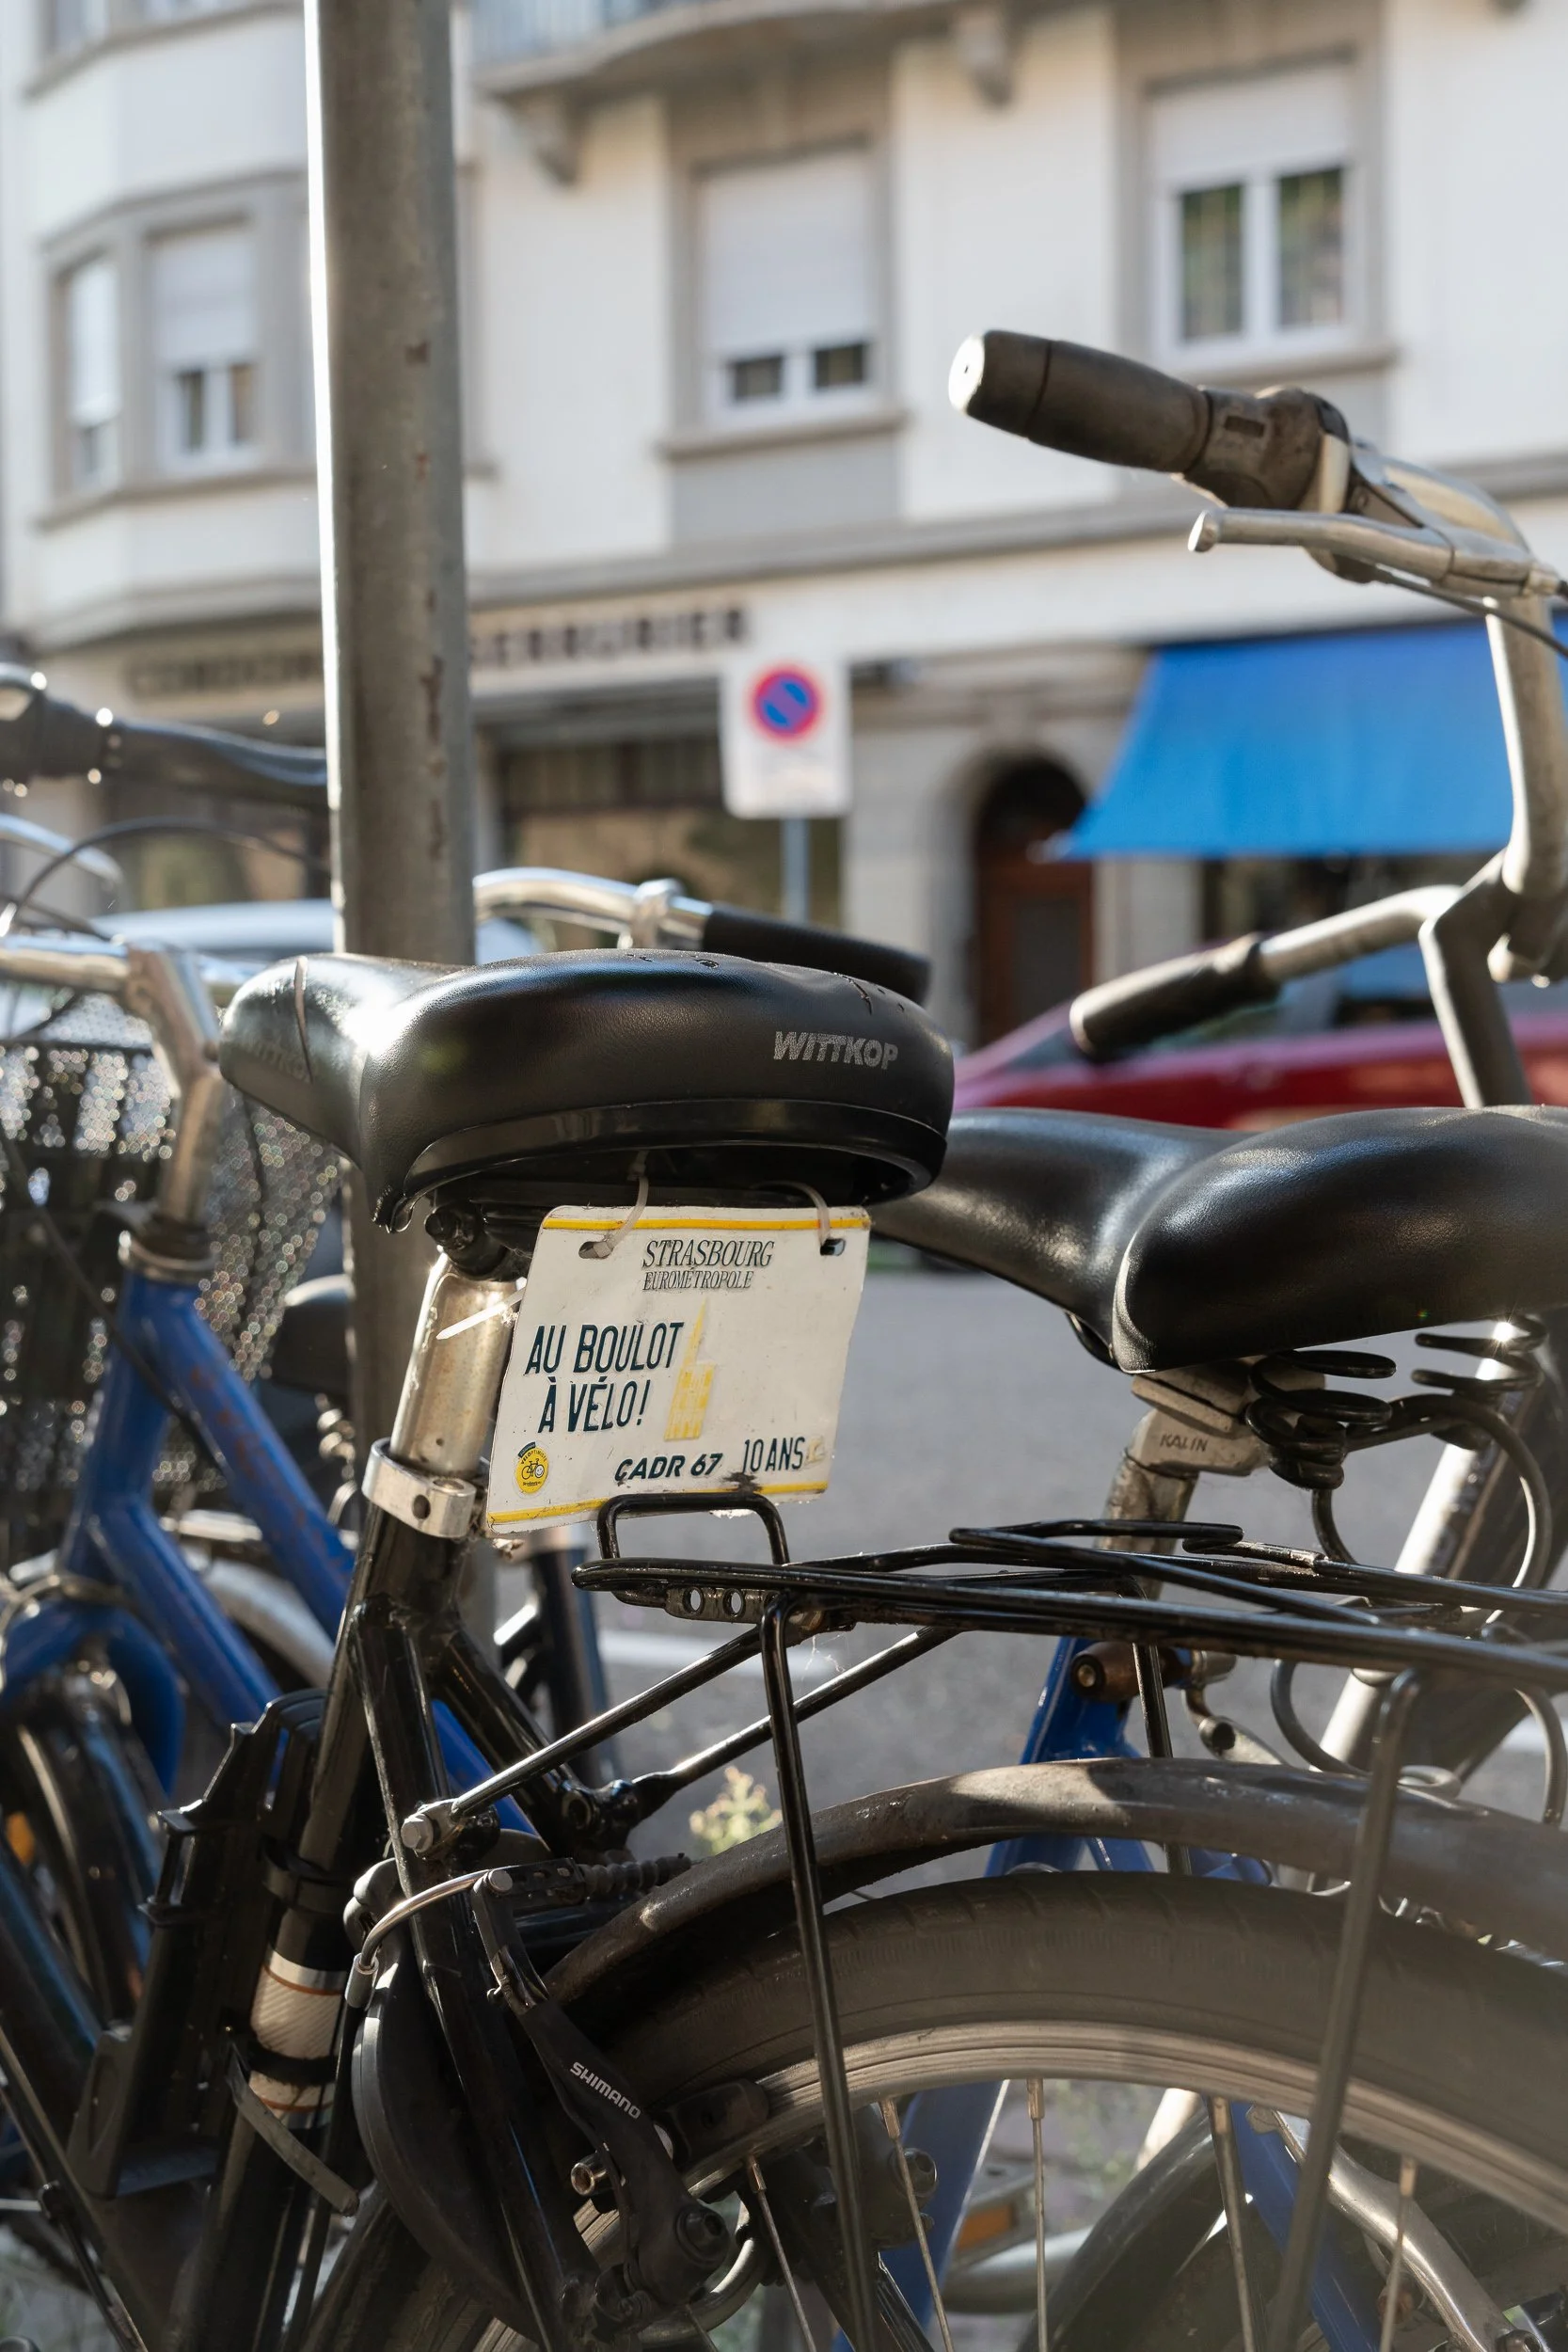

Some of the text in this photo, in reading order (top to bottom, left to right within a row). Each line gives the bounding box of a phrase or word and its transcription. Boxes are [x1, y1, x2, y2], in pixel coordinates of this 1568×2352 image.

[773, 1031, 899, 1071] WITTKOP
[641, 1238, 775, 1269] STRASBOURG
[642, 1266, 754, 1291] EUROMÉTROPOLE
[523, 1322, 685, 1375] AU BOULOT
[538, 1375, 651, 1433] À VÉLO!
[614, 1437, 805, 1482] CADR 67 10 ANS
[1160, 1434, 1209, 1453] KALIN
[570, 2061, 641, 2120] SHIMANO
